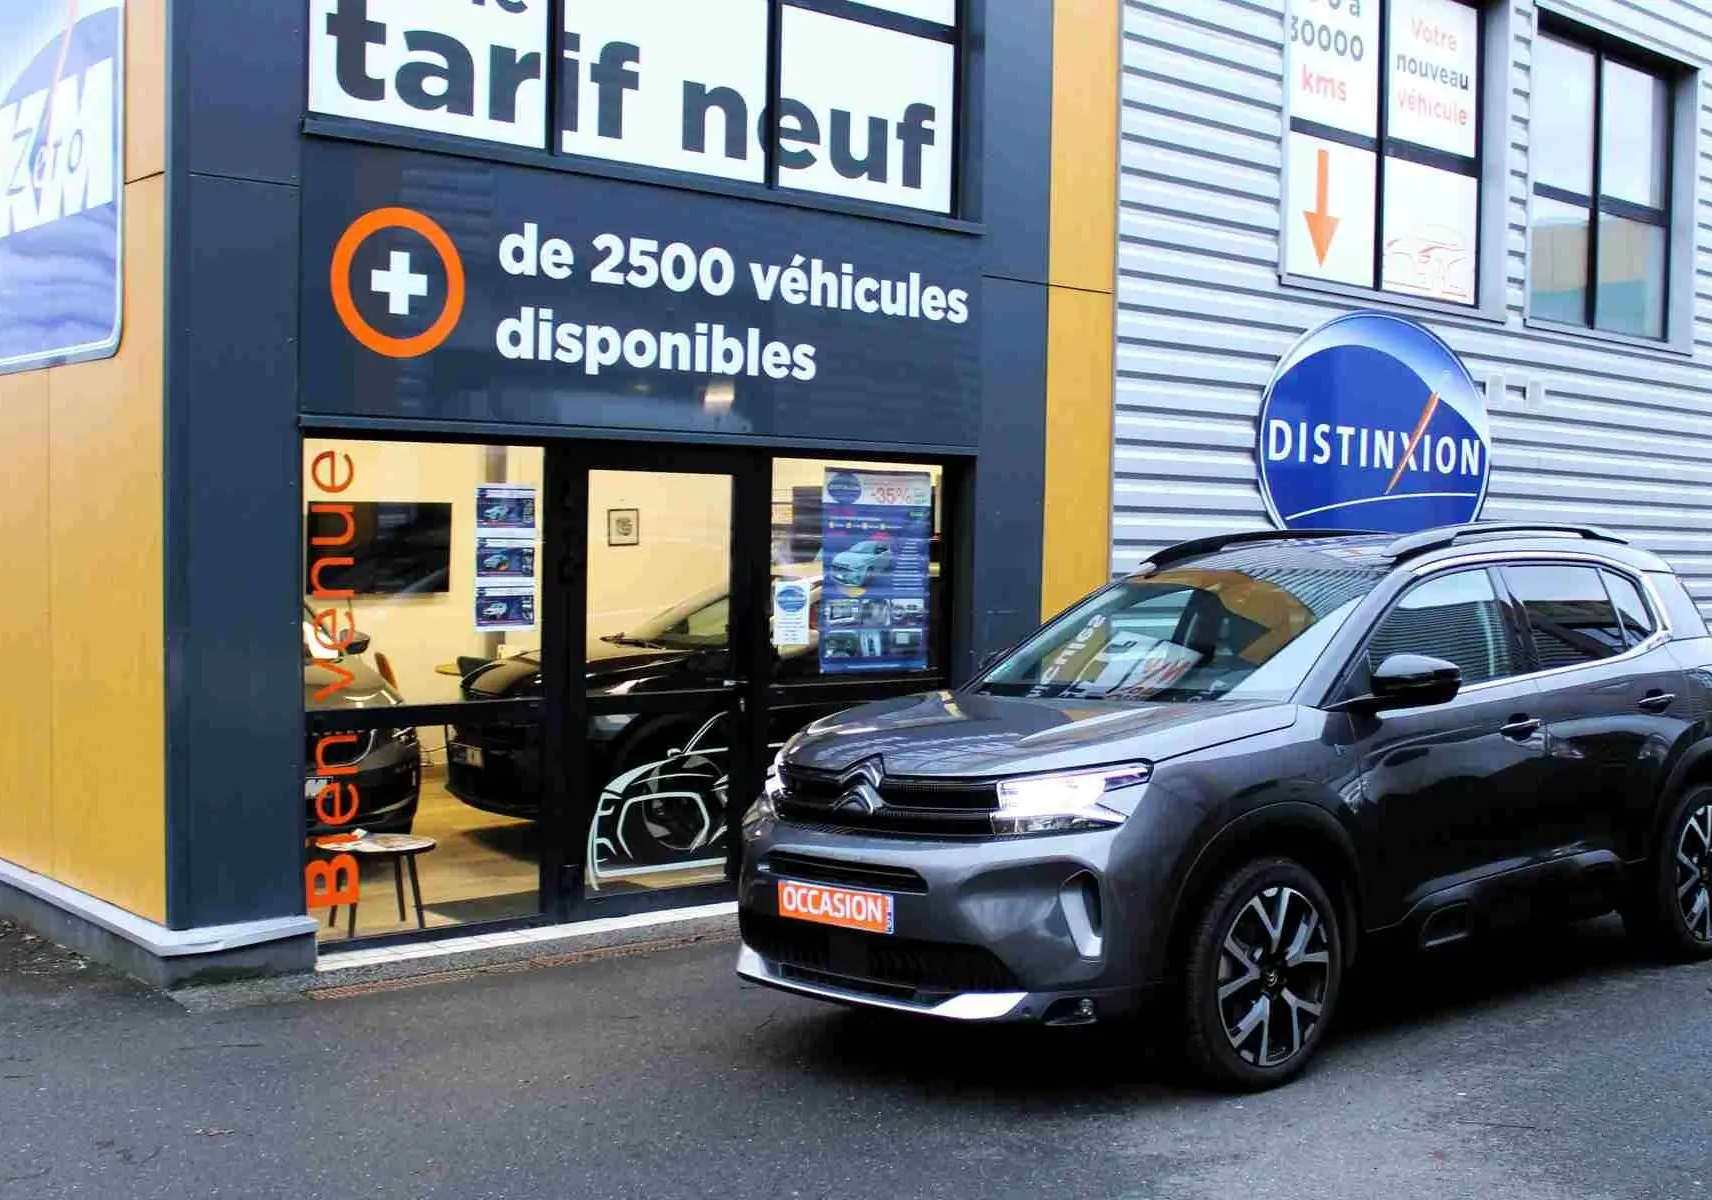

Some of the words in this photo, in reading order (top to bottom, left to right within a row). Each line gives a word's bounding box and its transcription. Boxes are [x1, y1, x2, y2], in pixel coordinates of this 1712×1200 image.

[1410, 16, 1459, 52] Votre
[1302, 64, 1347, 101] kms
[1396, 53, 1470, 91] nouveau
[326, 0, 640, 139] tarif
[682, 80, 936, 189] neuf
[1396, 87, 1468, 126] véhicule
[499, 222, 575, 280] de
[590, 233, 735, 296] 2500
[749, 253, 970, 324] véhicules
[495, 306, 818, 381] disponibles
[1267, 418, 1481, 477] DISTINXION
[782, 886, 883, 923] OCCASION
